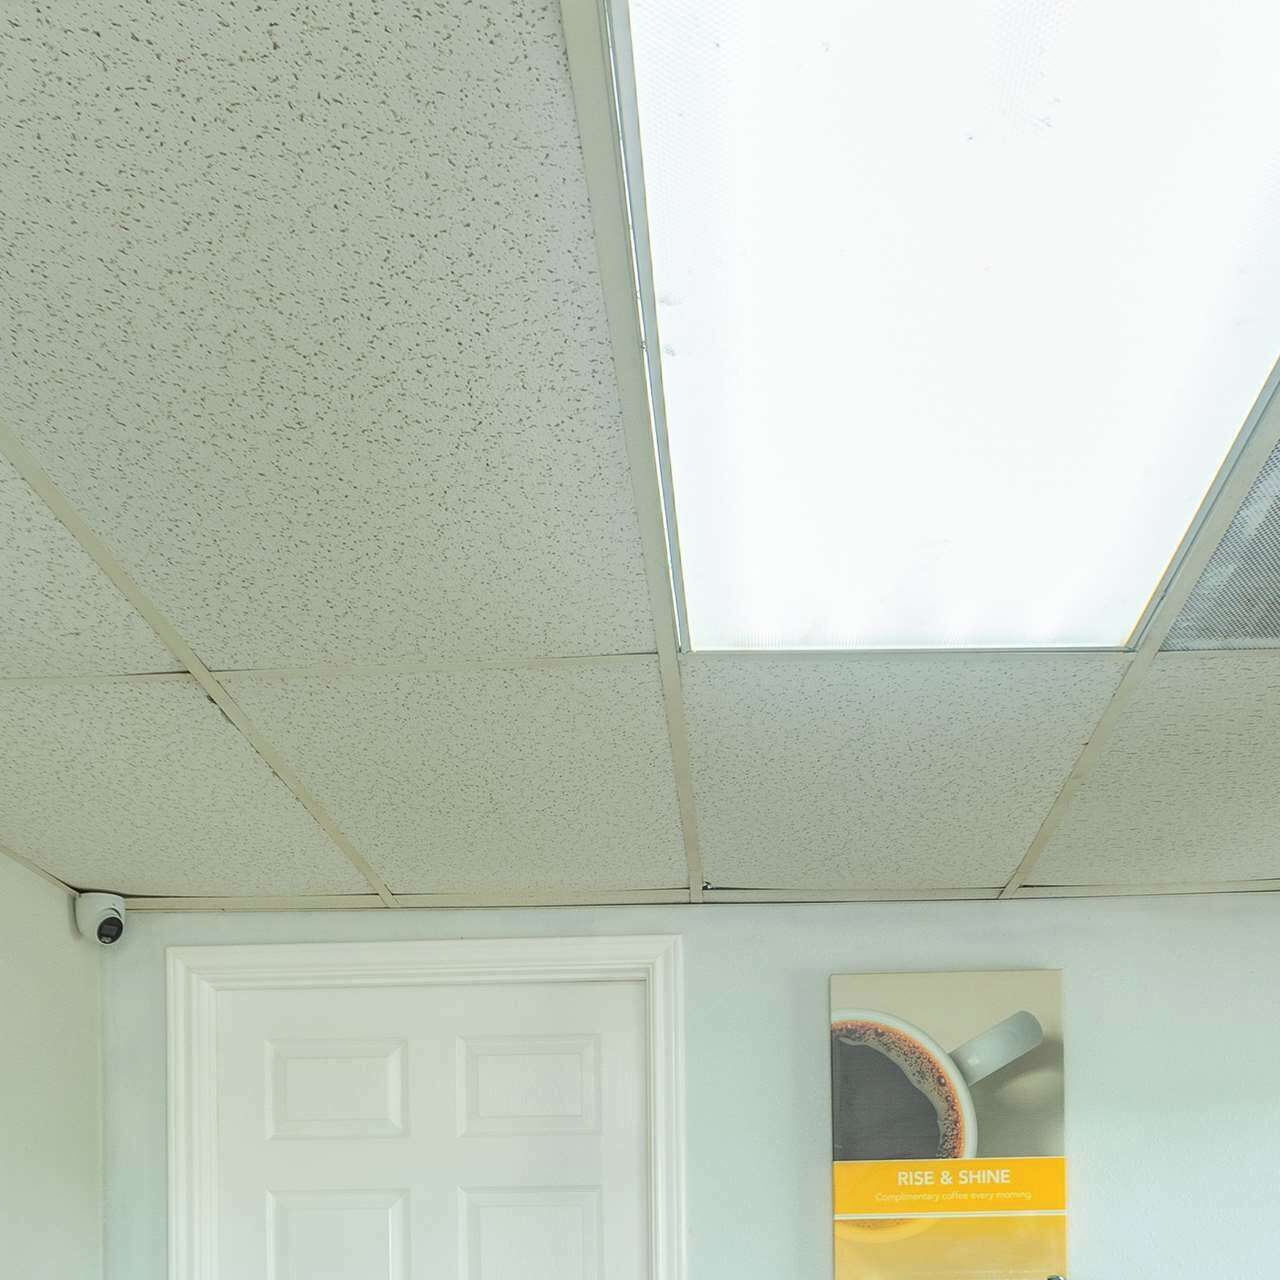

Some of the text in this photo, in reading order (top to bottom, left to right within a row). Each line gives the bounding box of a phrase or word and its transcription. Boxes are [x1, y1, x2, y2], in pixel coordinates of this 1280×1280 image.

[897, 1169, 1011, 1185] RISE & SHINE
[875, 1191, 939, 1202] Complimentary
[942, 1191, 969, 1200] coffee
[971, 1191, 995, 1201] every
